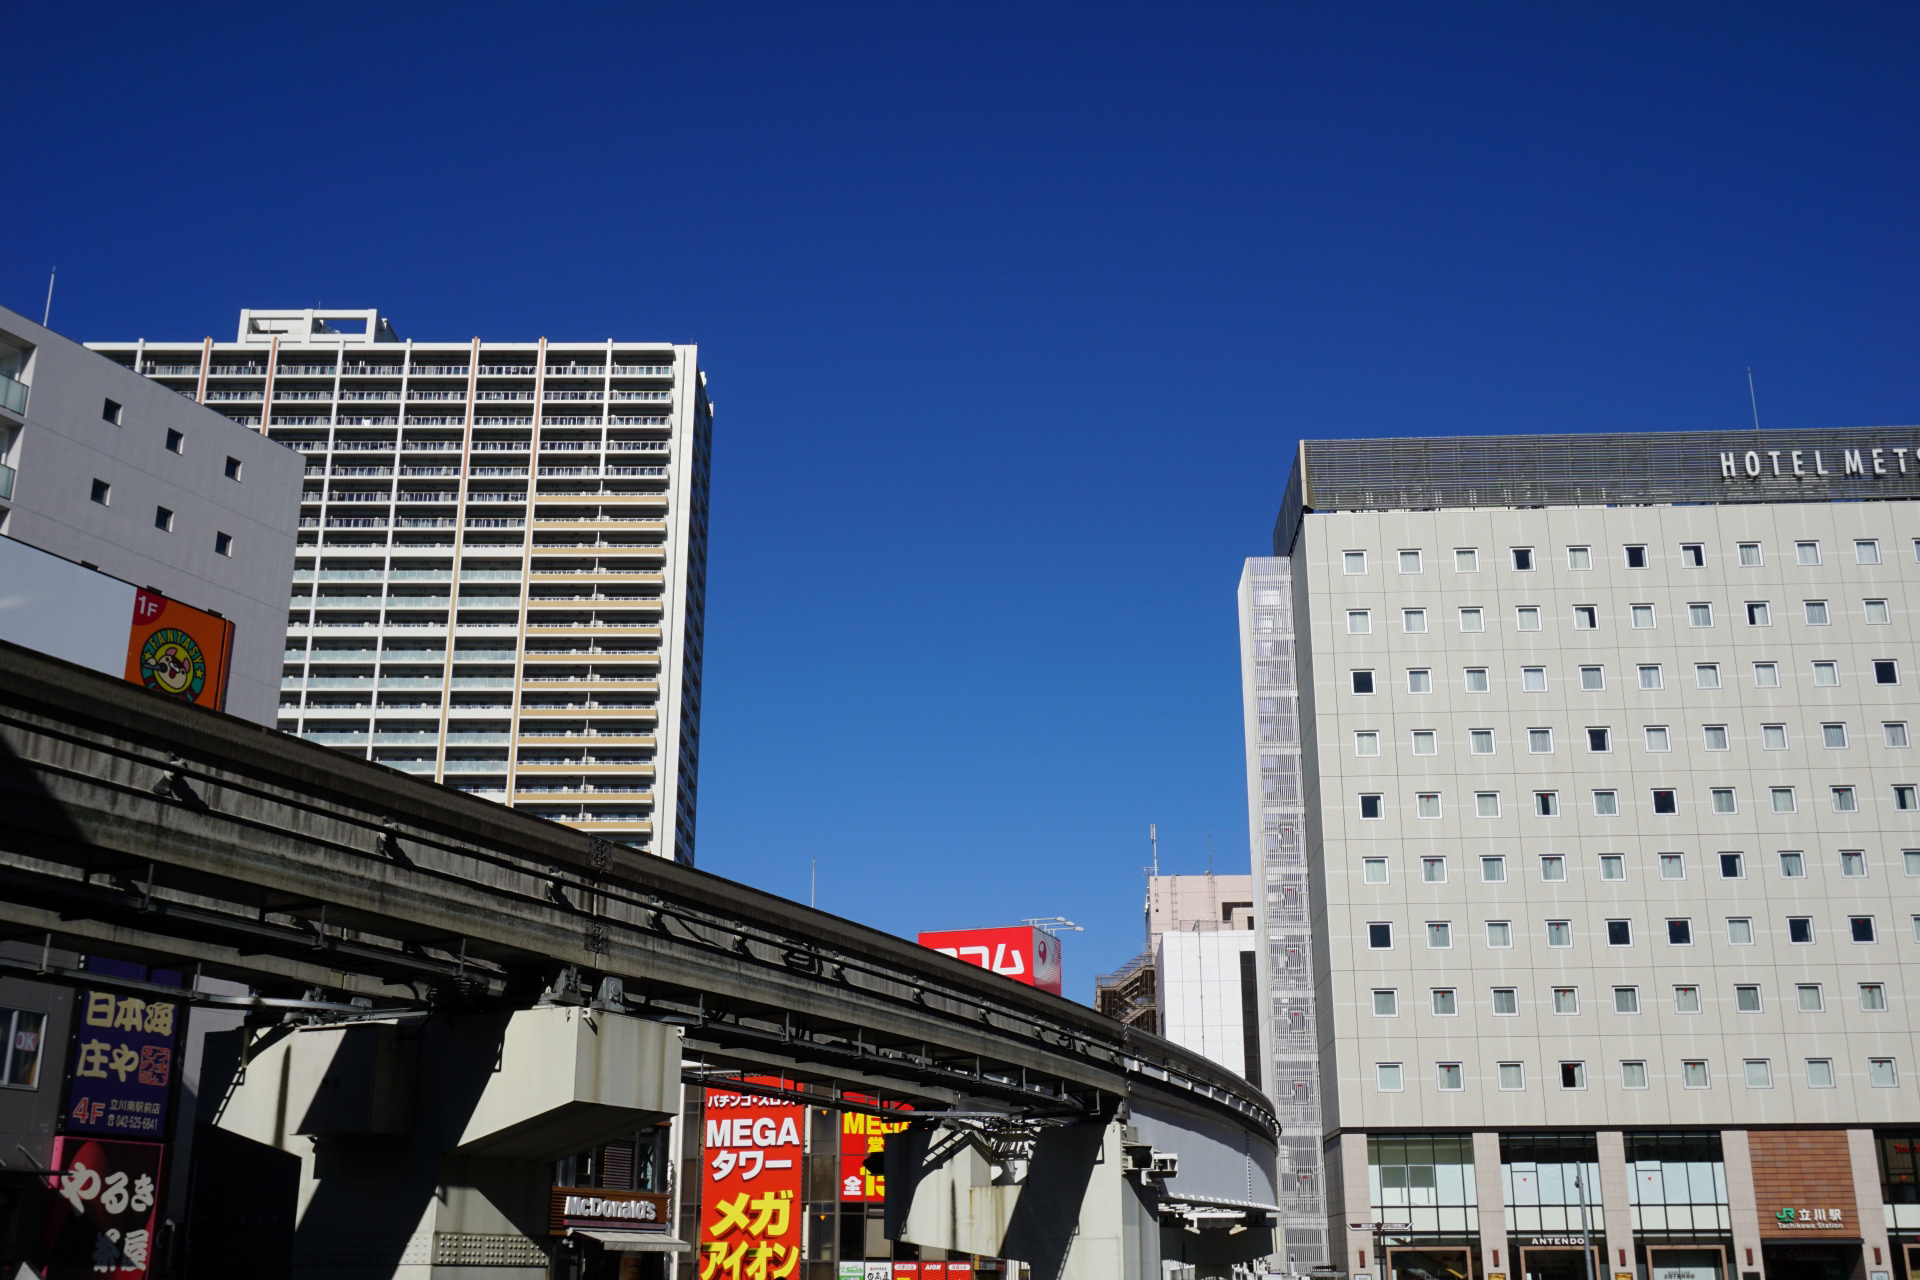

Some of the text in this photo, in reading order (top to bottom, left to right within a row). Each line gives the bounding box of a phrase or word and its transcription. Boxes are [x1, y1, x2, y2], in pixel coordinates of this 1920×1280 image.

[1720, 448, 1920, 477] HOTEL MET
[138, 596, 158, 617] 1F
[149, 629, 204, 664] FANTASY
[86, 990, 175, 1037] 日本海
[15, 1031, 38, 1051] OK
[76, 1038, 139, 1083] 庄や
[72, 1097, 106, 1125] 4F
[109, 1098, 161, 1115] 立川南駅前店
[706, 1117, 800, 1148] MEGA
[711, 1150, 792, 1182] タワー
[59, 1161, 155, 1217] やるき
[564, 1196, 657, 1221] McDonald's
[709, 1190, 794, 1238] メガ
[1776, 1208, 1795, 1220] JR
[1798, 1208, 1843, 1221] 立川駅
[1817, 1222, 1844, 1230] Station
[1531, 1237, 1585, 1246] ANTENDO
[701, 1240, 799, 1280] アイオン
